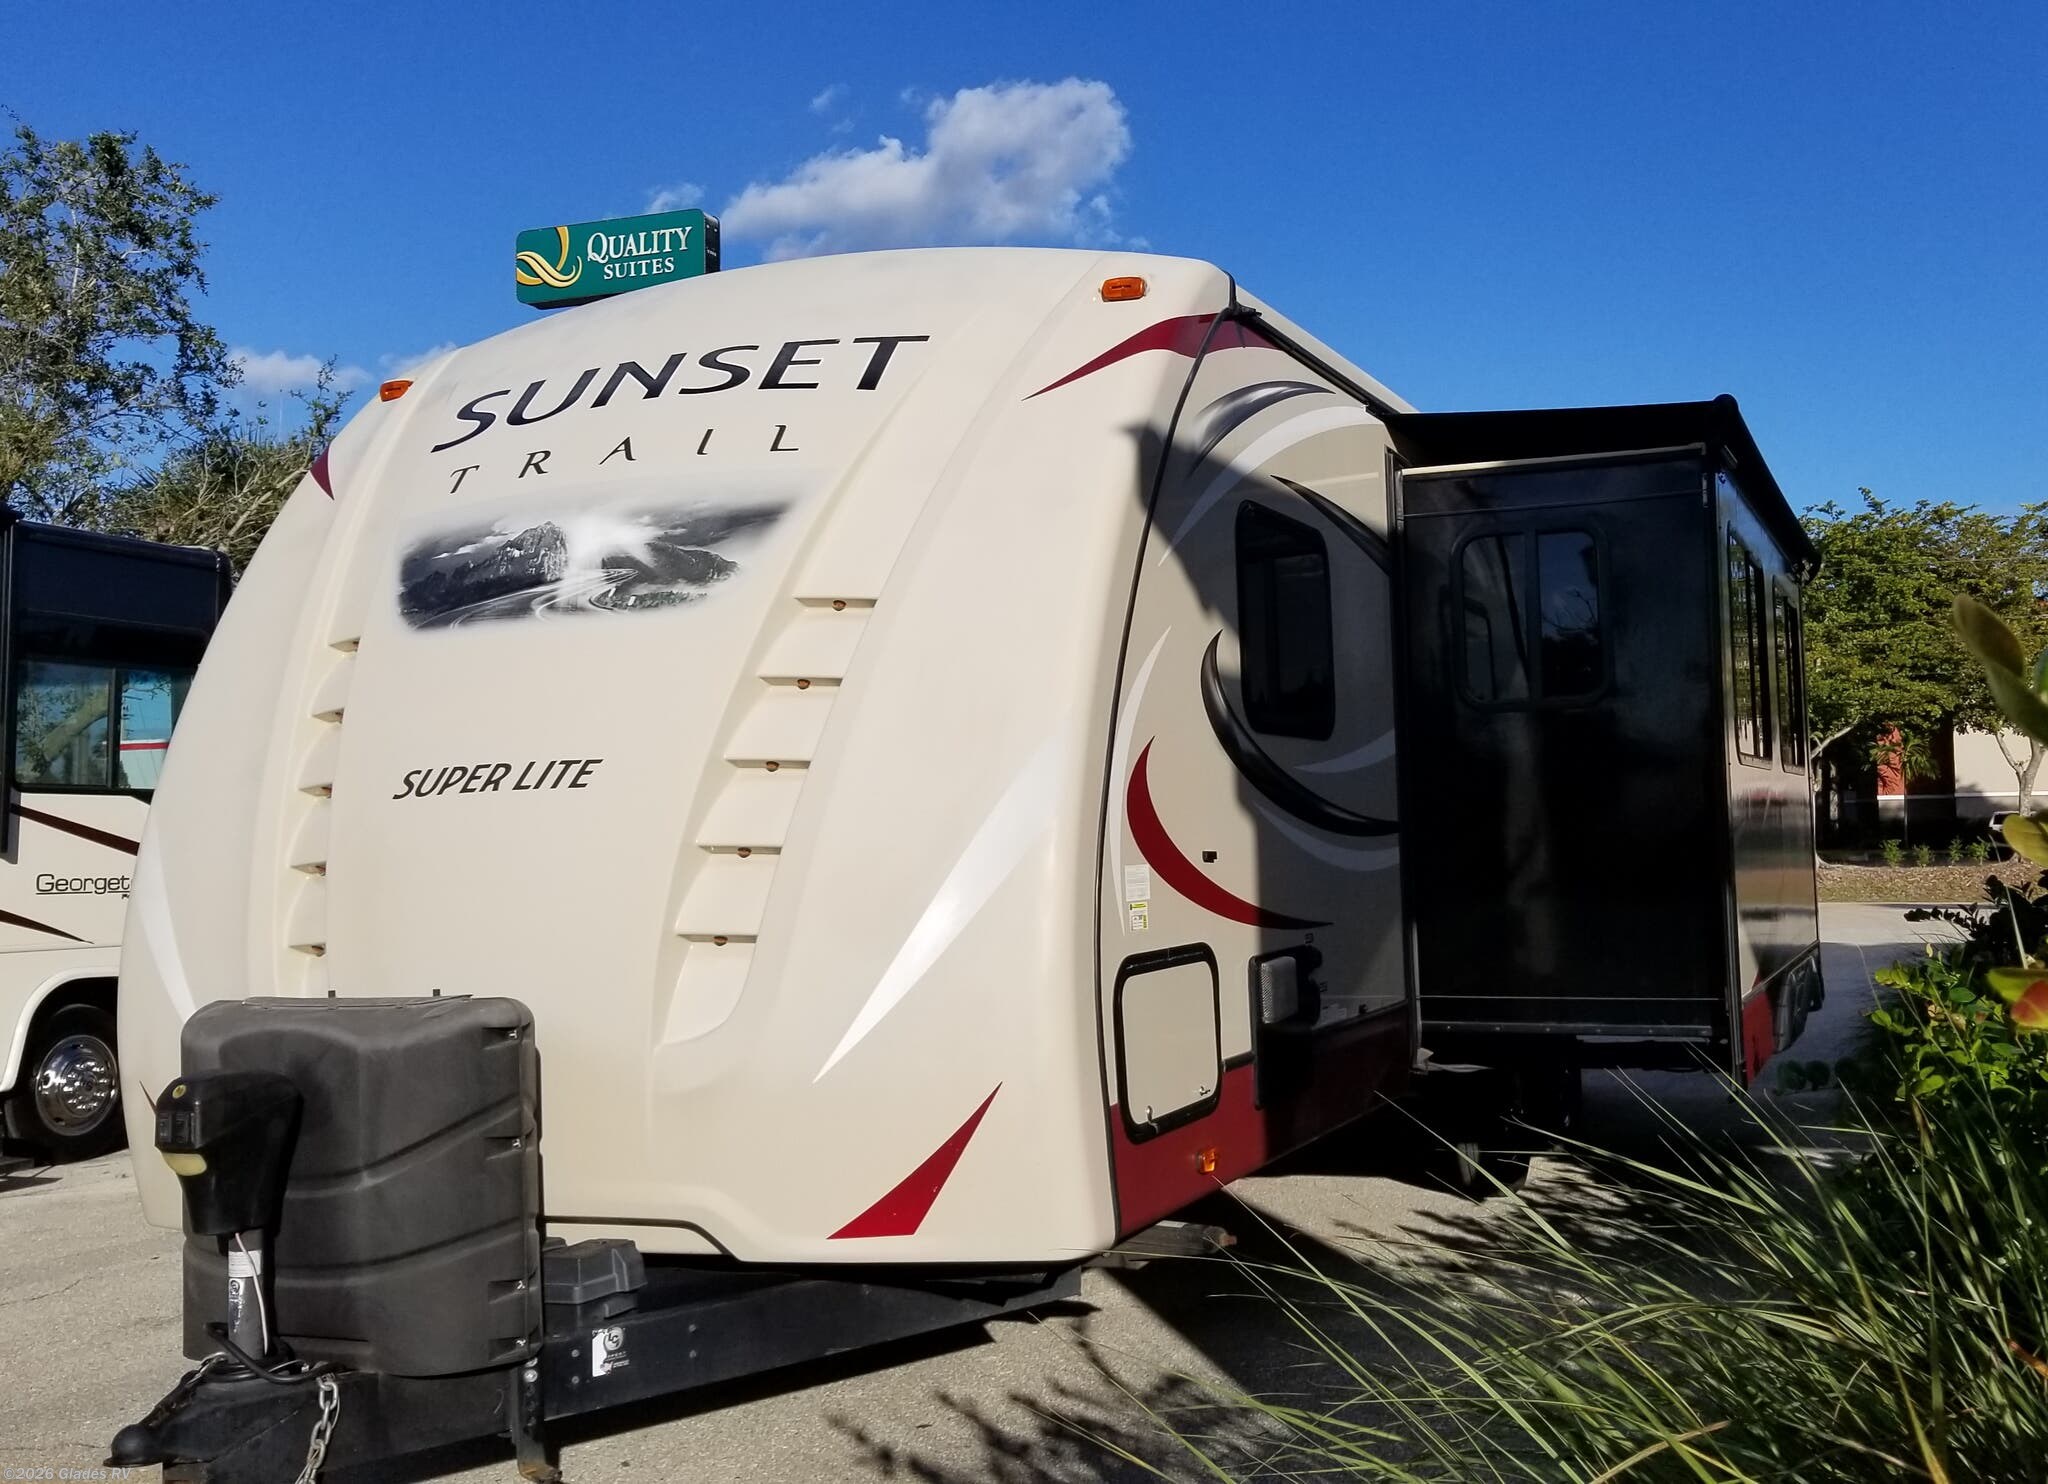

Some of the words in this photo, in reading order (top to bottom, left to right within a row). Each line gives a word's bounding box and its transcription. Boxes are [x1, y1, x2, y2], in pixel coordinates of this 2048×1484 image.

[587, 226, 693, 264] QUALITY
[603, 257, 675, 280] SUITES
[431, 335, 930, 453] SUNSET
[450, 425, 799, 494] TRAIL
[392, 762, 513, 800] SUPER
[511, 758, 604, 791] LITE
[35, 873, 131, 895] Georget
